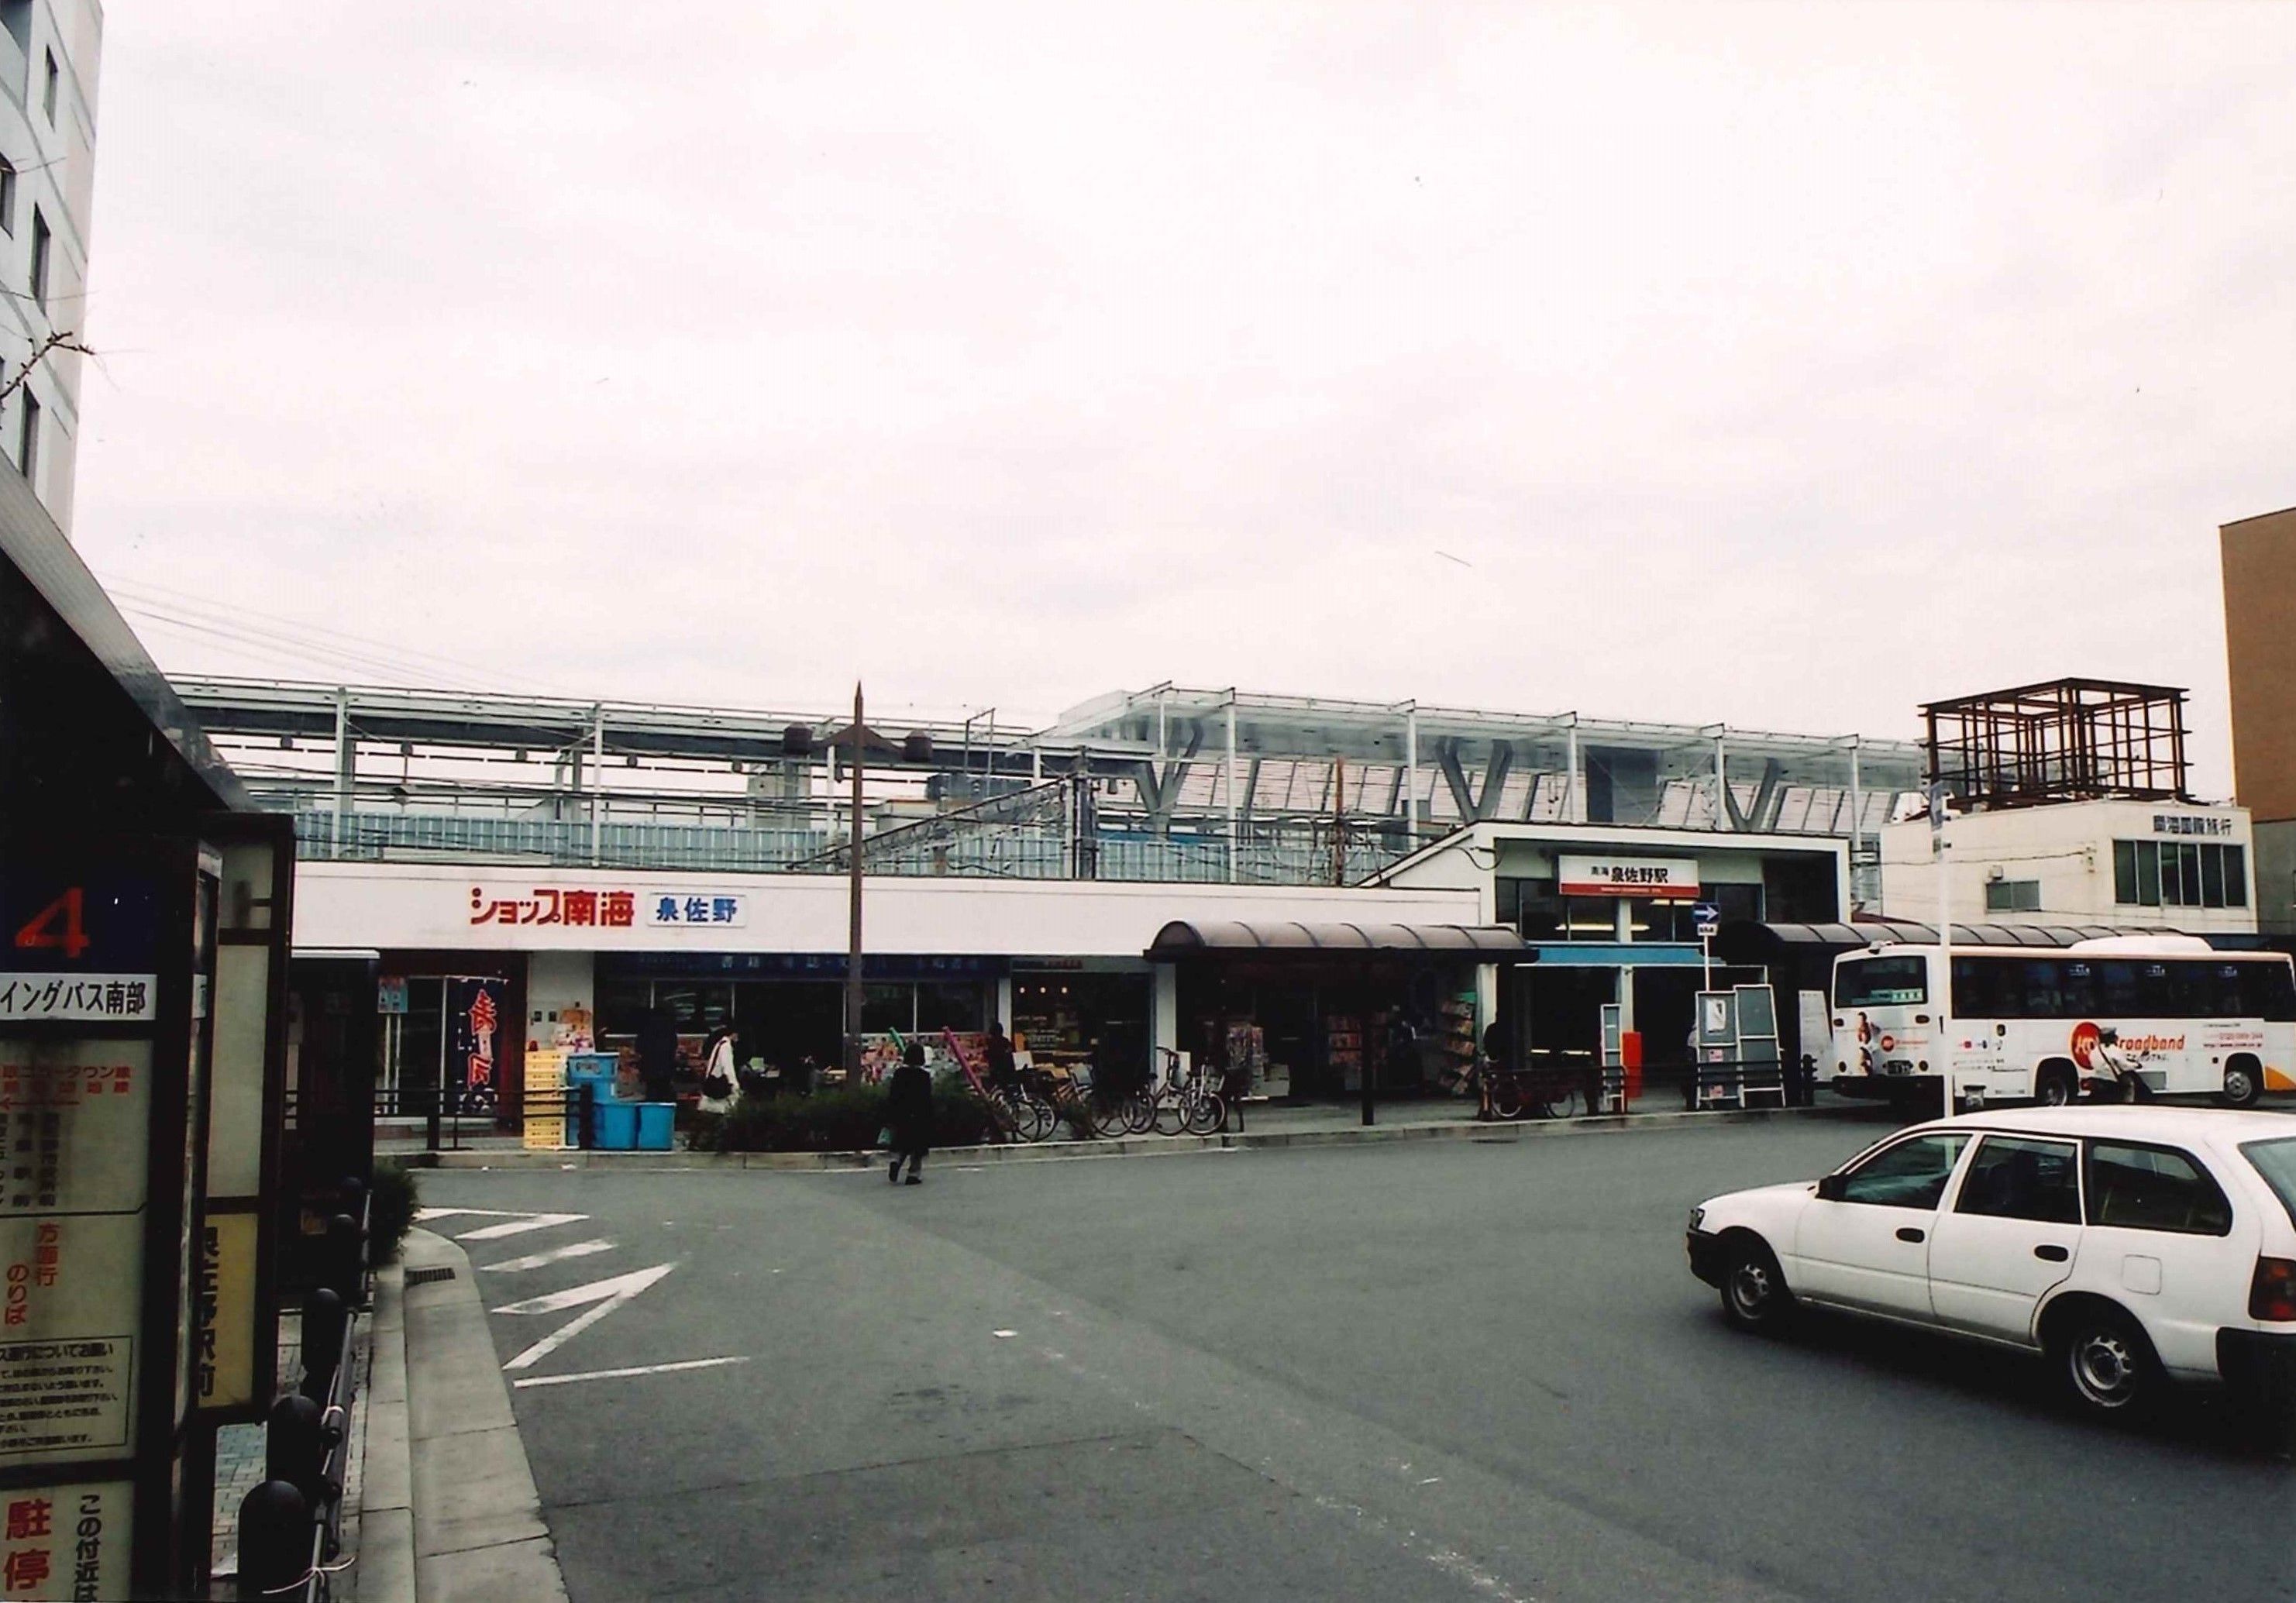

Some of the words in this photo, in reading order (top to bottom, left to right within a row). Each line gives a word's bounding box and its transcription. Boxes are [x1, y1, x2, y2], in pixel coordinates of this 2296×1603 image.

[1611, 867, 1669, 884] 泉佐野駅
[15, 887, 90, 958] 4
[470, 888, 635, 926] ショップ南海
[656, 897, 737, 923] 泉佐野
[0, 979, 147, 1014] イングバス南部
[2117, 1035, 2185, 1051] roadband
[36, 1223, 60, 1286] 方面行
[5, 1264, 29, 1324] のりば
